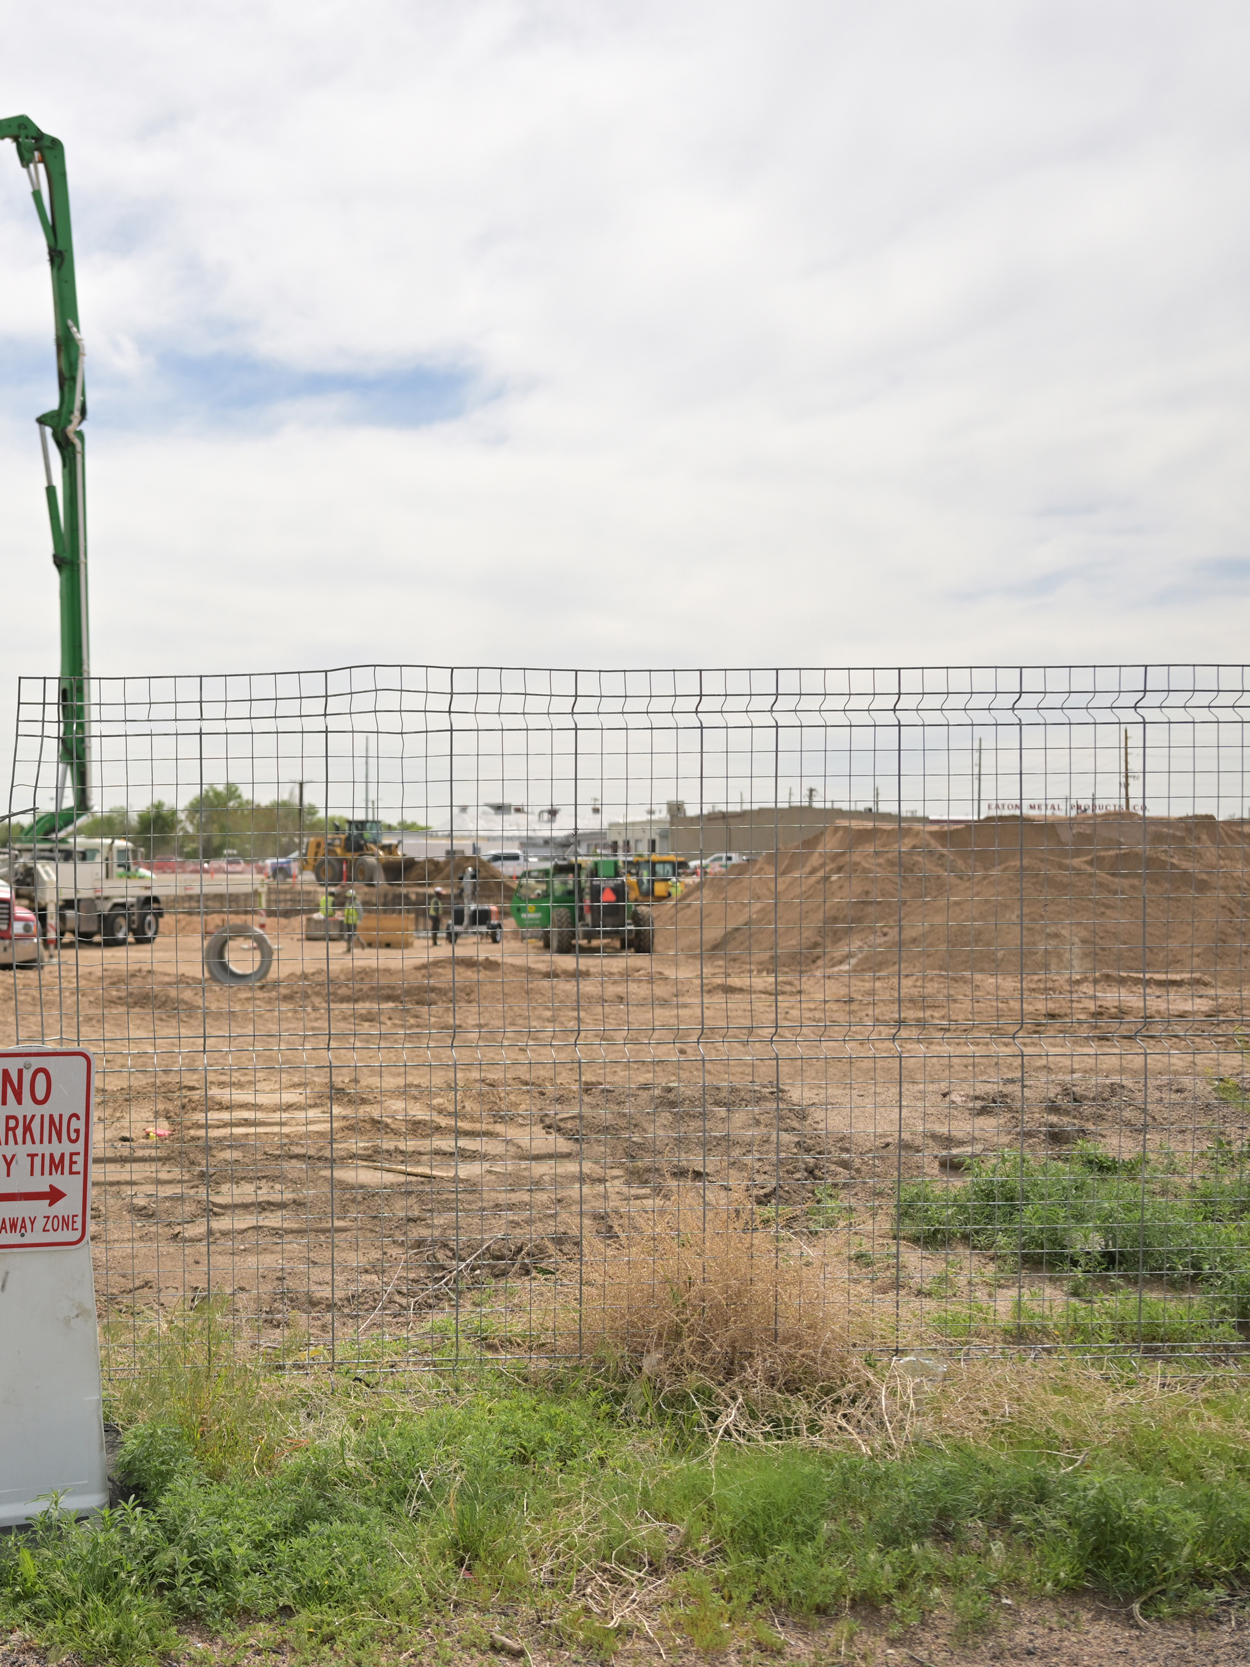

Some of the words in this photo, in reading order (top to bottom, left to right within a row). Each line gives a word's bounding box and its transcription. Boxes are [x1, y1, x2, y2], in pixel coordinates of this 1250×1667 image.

[987, 803, 1021, 811] EATON
[1029, 803, 1062, 811] METAL
[1, 1067, 52, 1106] NO
[26, 1151, 81, 1177] TIME
[0, 1215, 37, 1234] AWAY
[42, 1214, 79, 1233] ZONE
